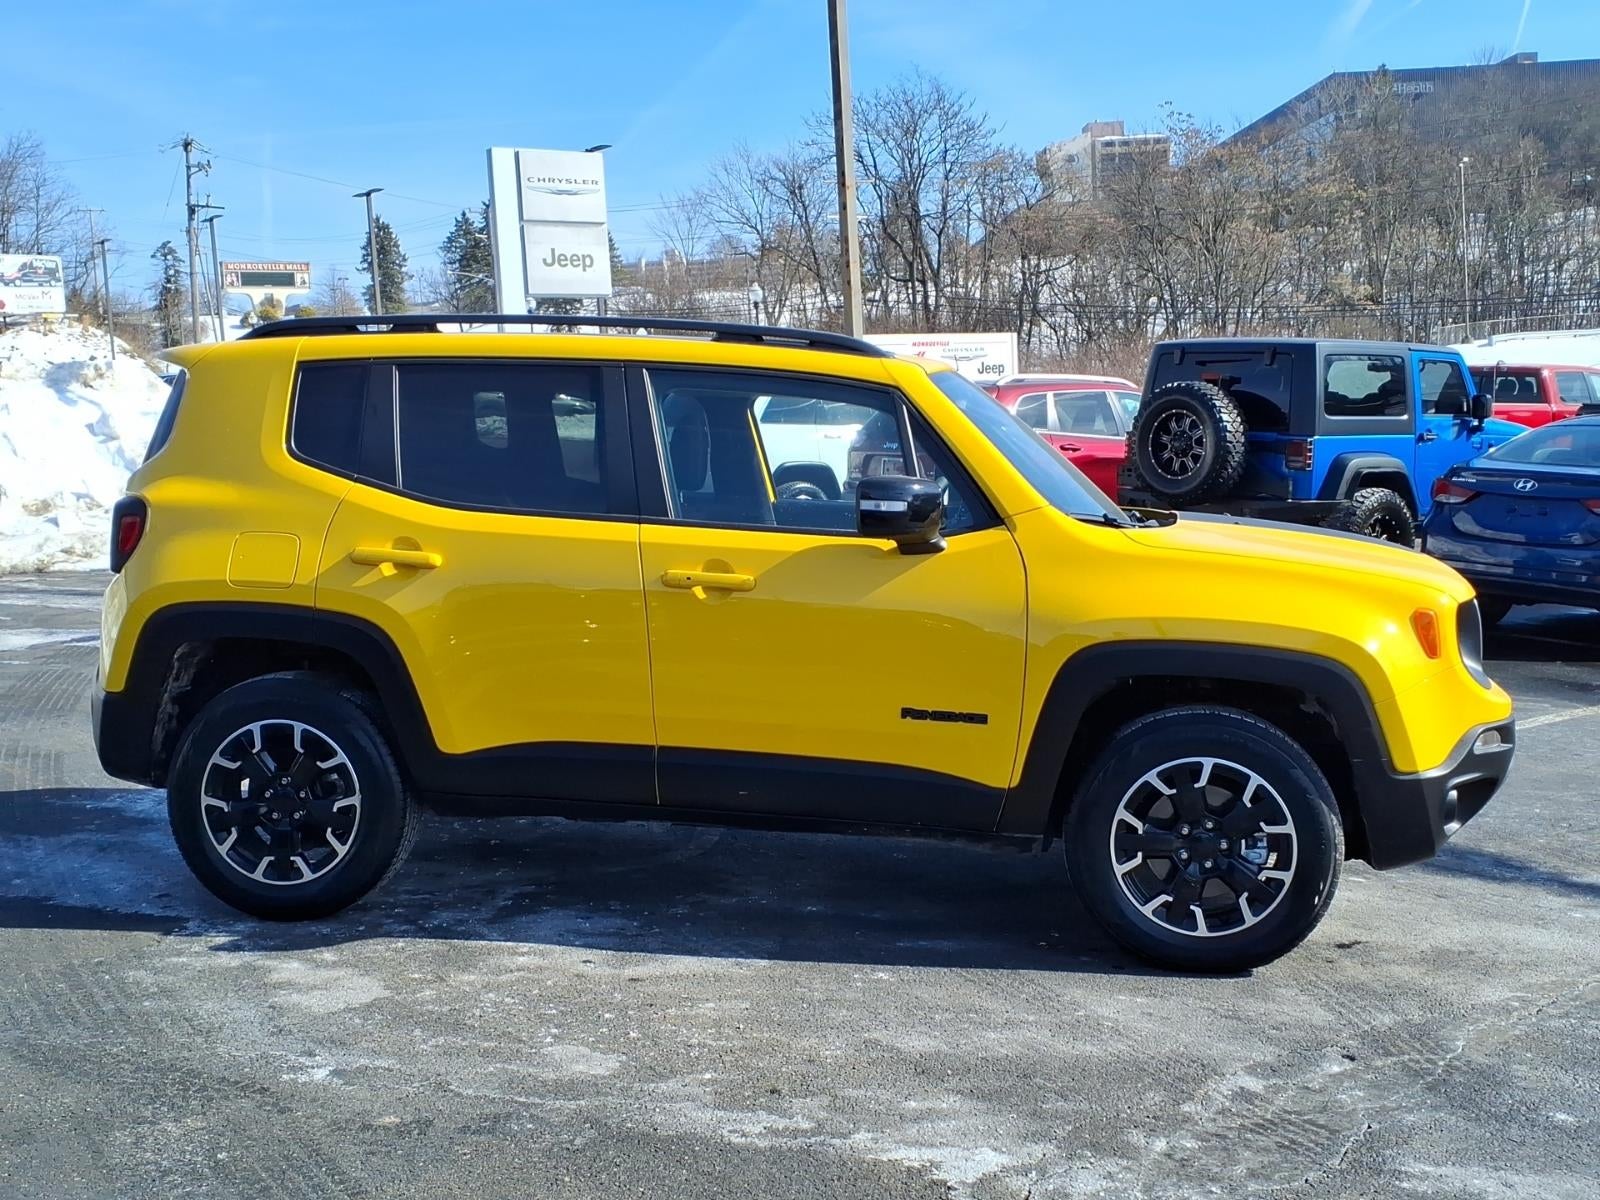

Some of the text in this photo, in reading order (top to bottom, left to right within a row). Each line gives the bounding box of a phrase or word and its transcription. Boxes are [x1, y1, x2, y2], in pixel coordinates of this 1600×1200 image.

[527, 176, 600, 185] CHRYSLER
[542, 247, 594, 272] Jeep
[977, 361, 1005, 376] Jeep
[883, 441, 898, 449] Jeep
[901, 707, 988, 725] RENEGADE
